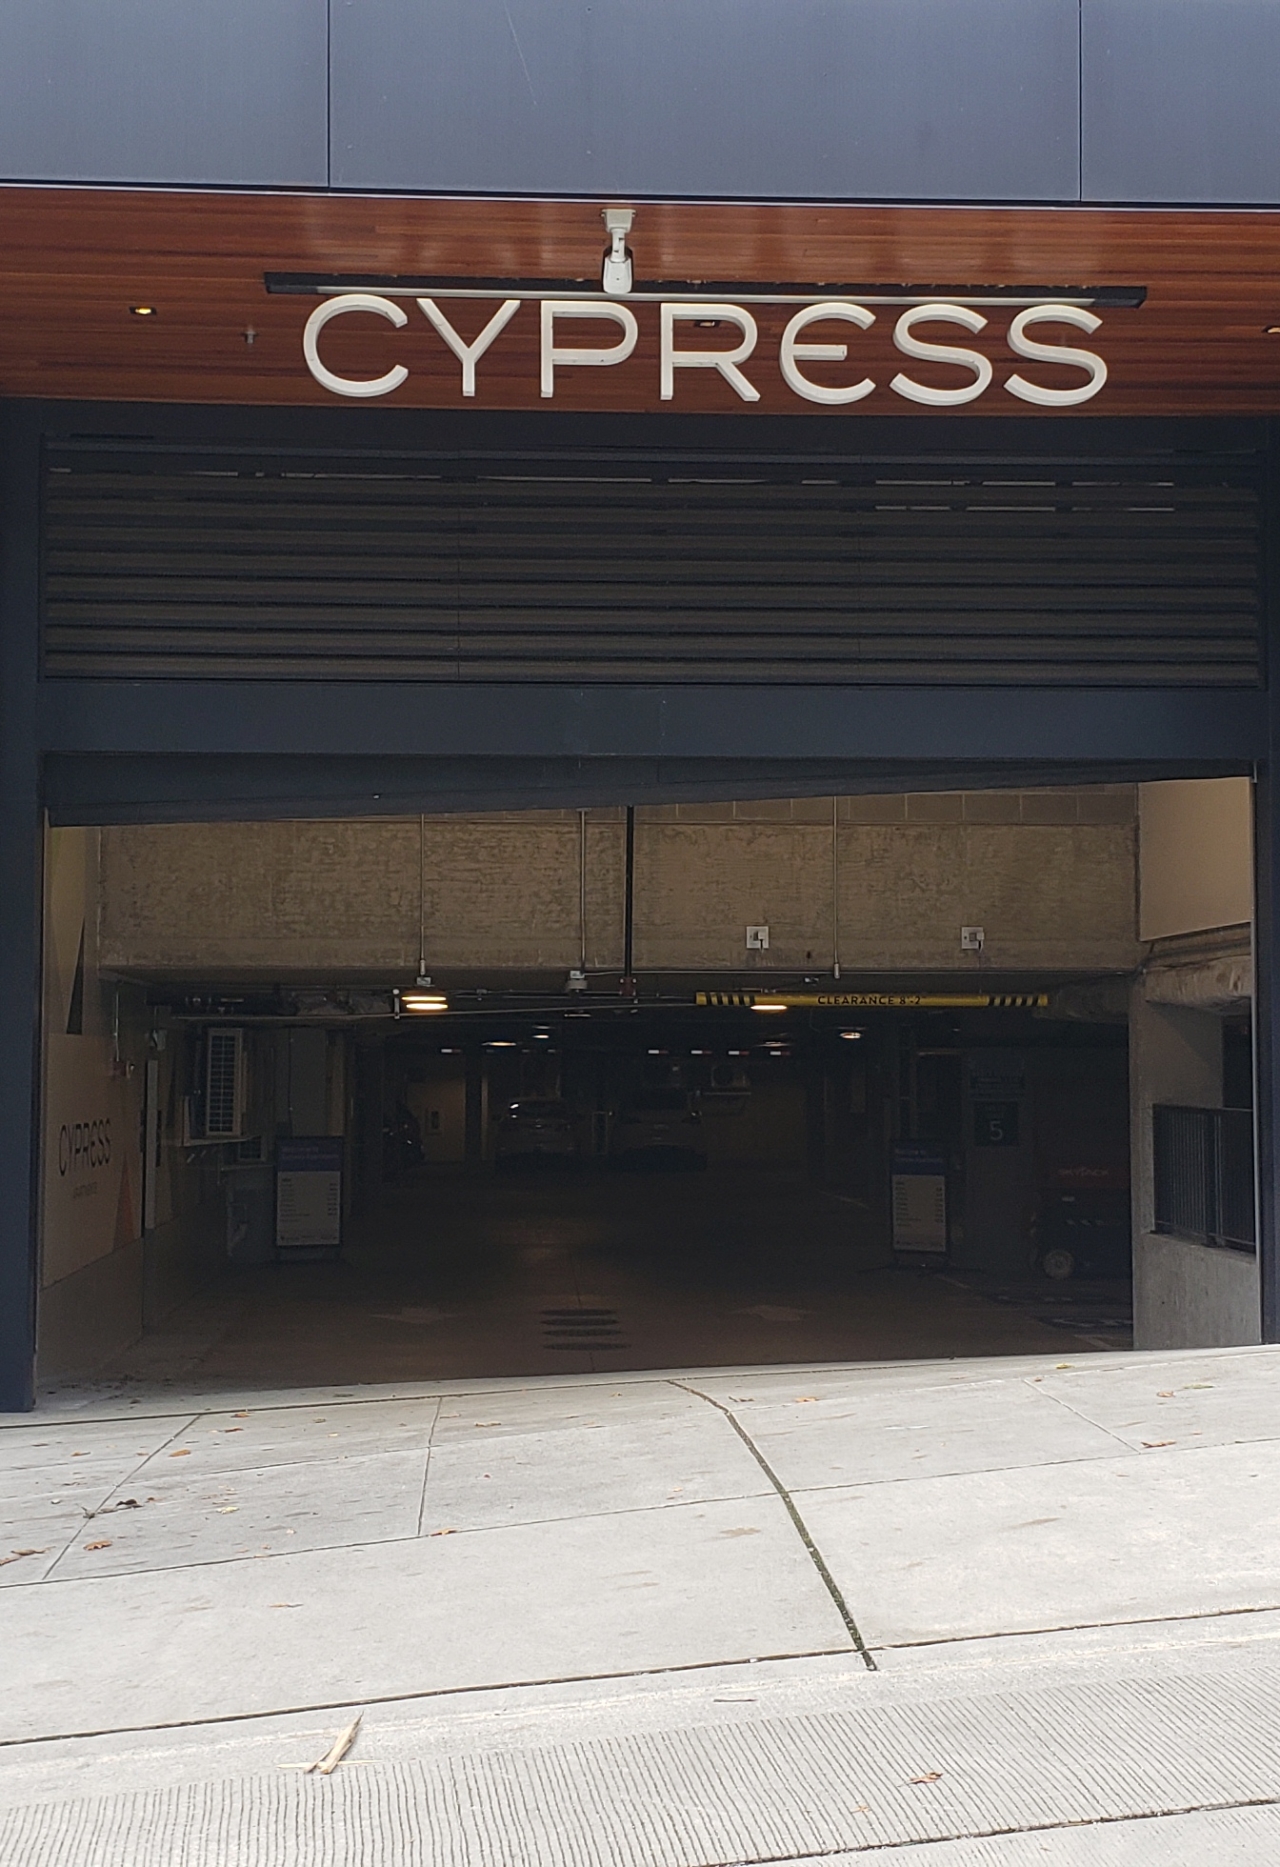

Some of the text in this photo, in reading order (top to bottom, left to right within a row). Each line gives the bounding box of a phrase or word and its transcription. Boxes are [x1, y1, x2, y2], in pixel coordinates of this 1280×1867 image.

[303, 293, 1109, 407] CYPRESS
[817, 995, 895, 1005] CLEARANCE
[58, 1117, 111, 1177] CYPRESS
[990, 1120, 1003, 1141] 5
